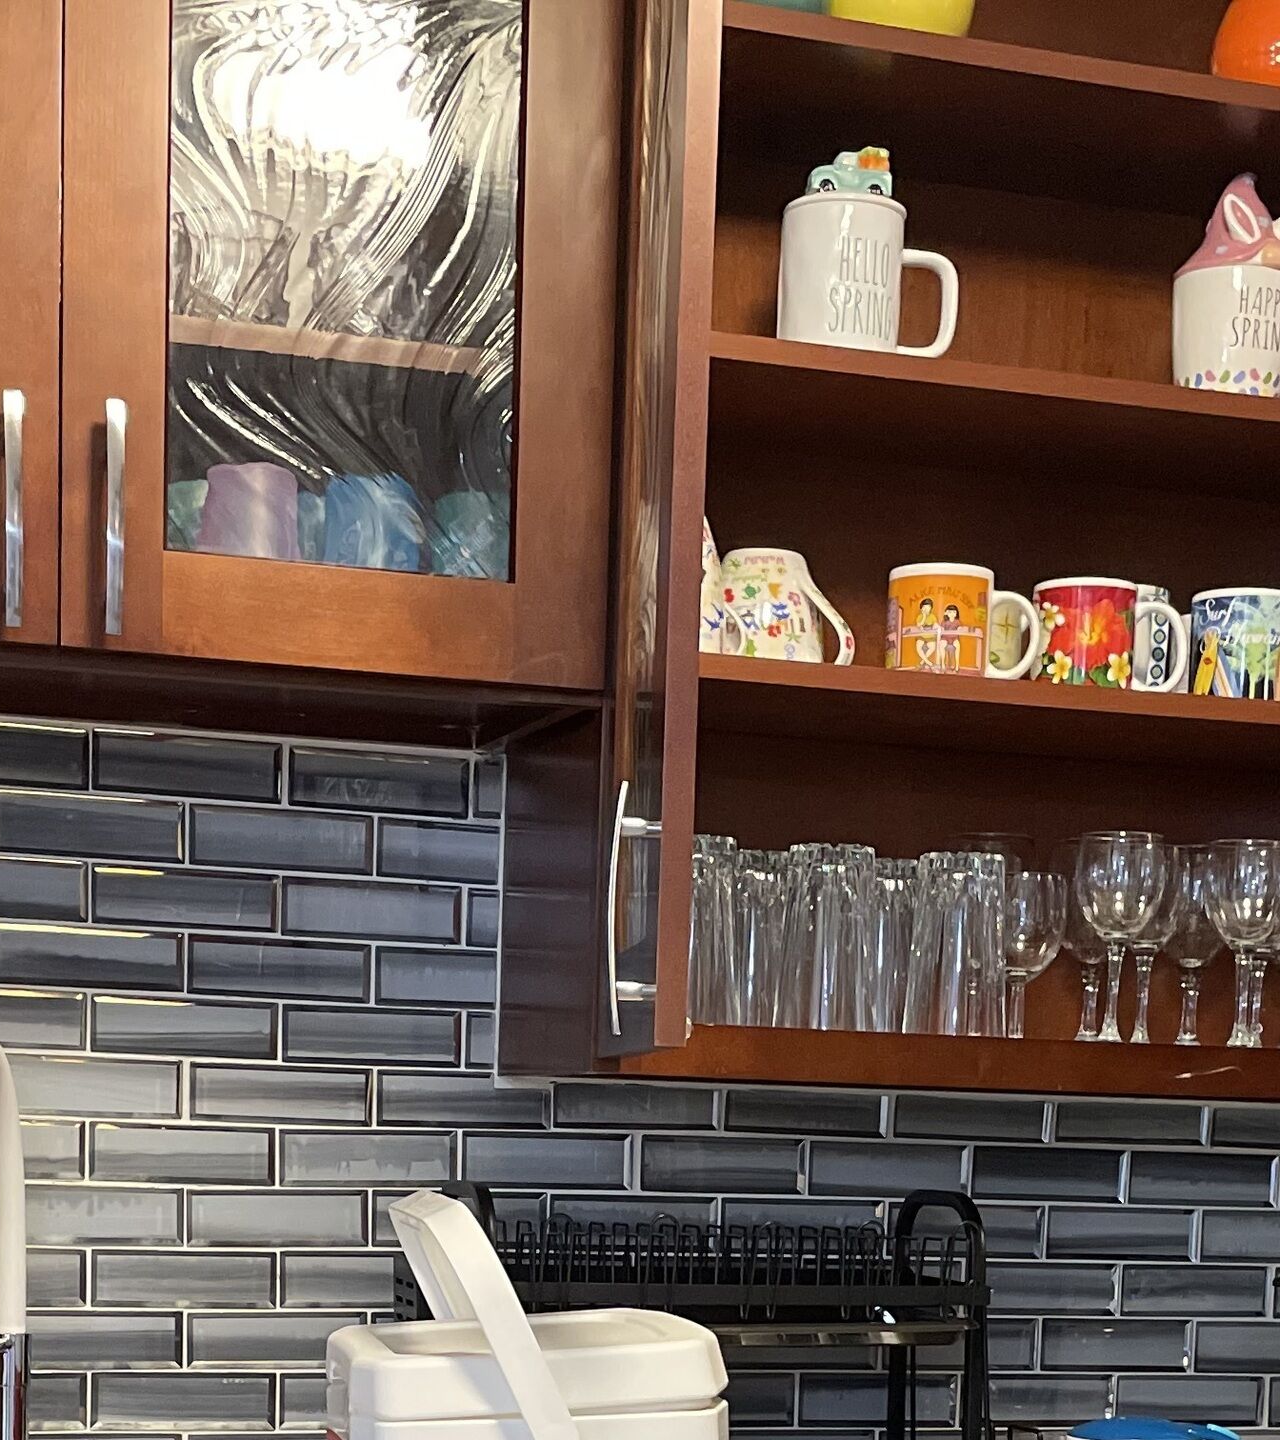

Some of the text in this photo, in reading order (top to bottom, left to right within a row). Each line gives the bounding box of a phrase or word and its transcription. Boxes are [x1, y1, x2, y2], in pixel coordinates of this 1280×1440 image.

[839, 235, 890, 288] HELLO
[828, 286, 892, 341] SPRING
[1199, 598, 1235, 628] Surf
